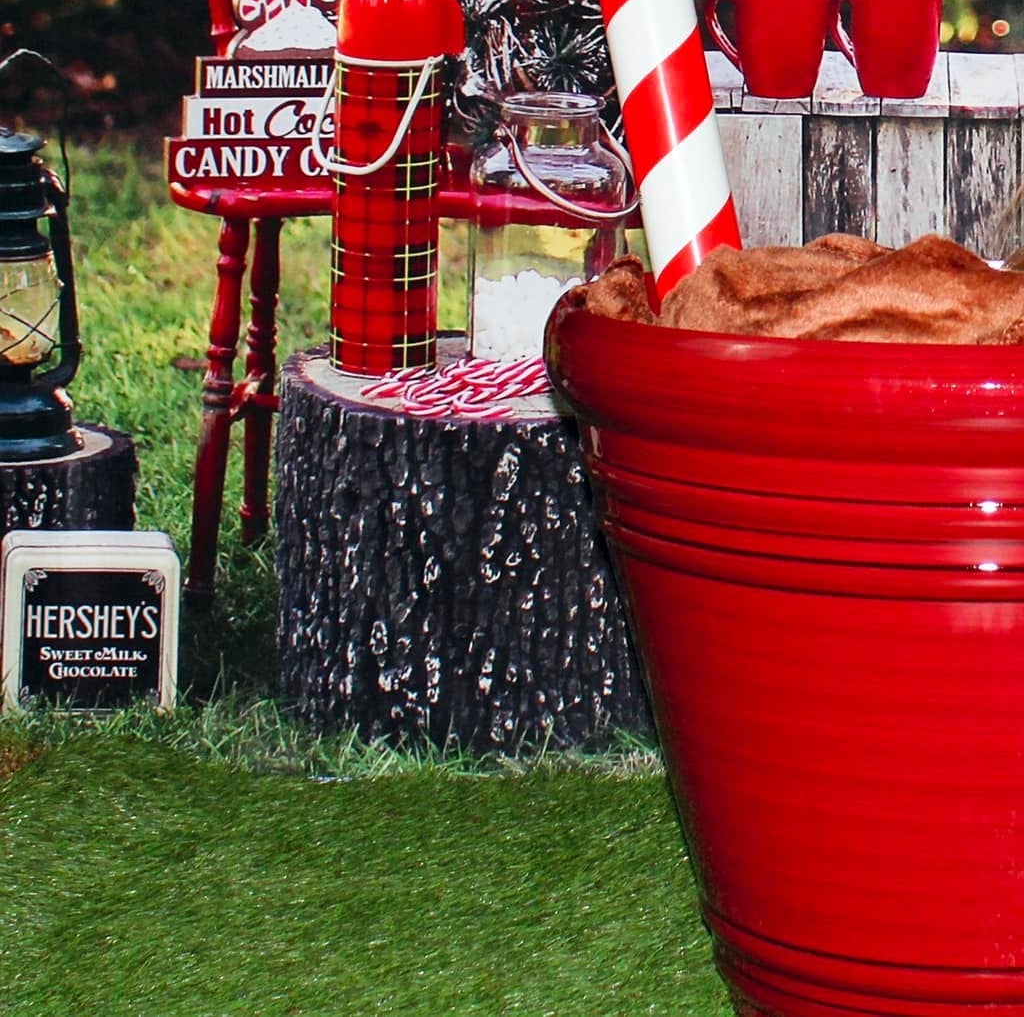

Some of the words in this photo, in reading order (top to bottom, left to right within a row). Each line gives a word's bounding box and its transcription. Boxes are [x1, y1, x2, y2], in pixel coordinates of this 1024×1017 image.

[202, 108, 254, 135] Hot
[174, 145, 291, 178] CANDY
[25, 600, 158, 639] HERSHEY'S
[40, 646, 93, 661] SWEET
[94, 646, 147, 662] MILK
[49, 662, 137, 679] CHOCOLATE
